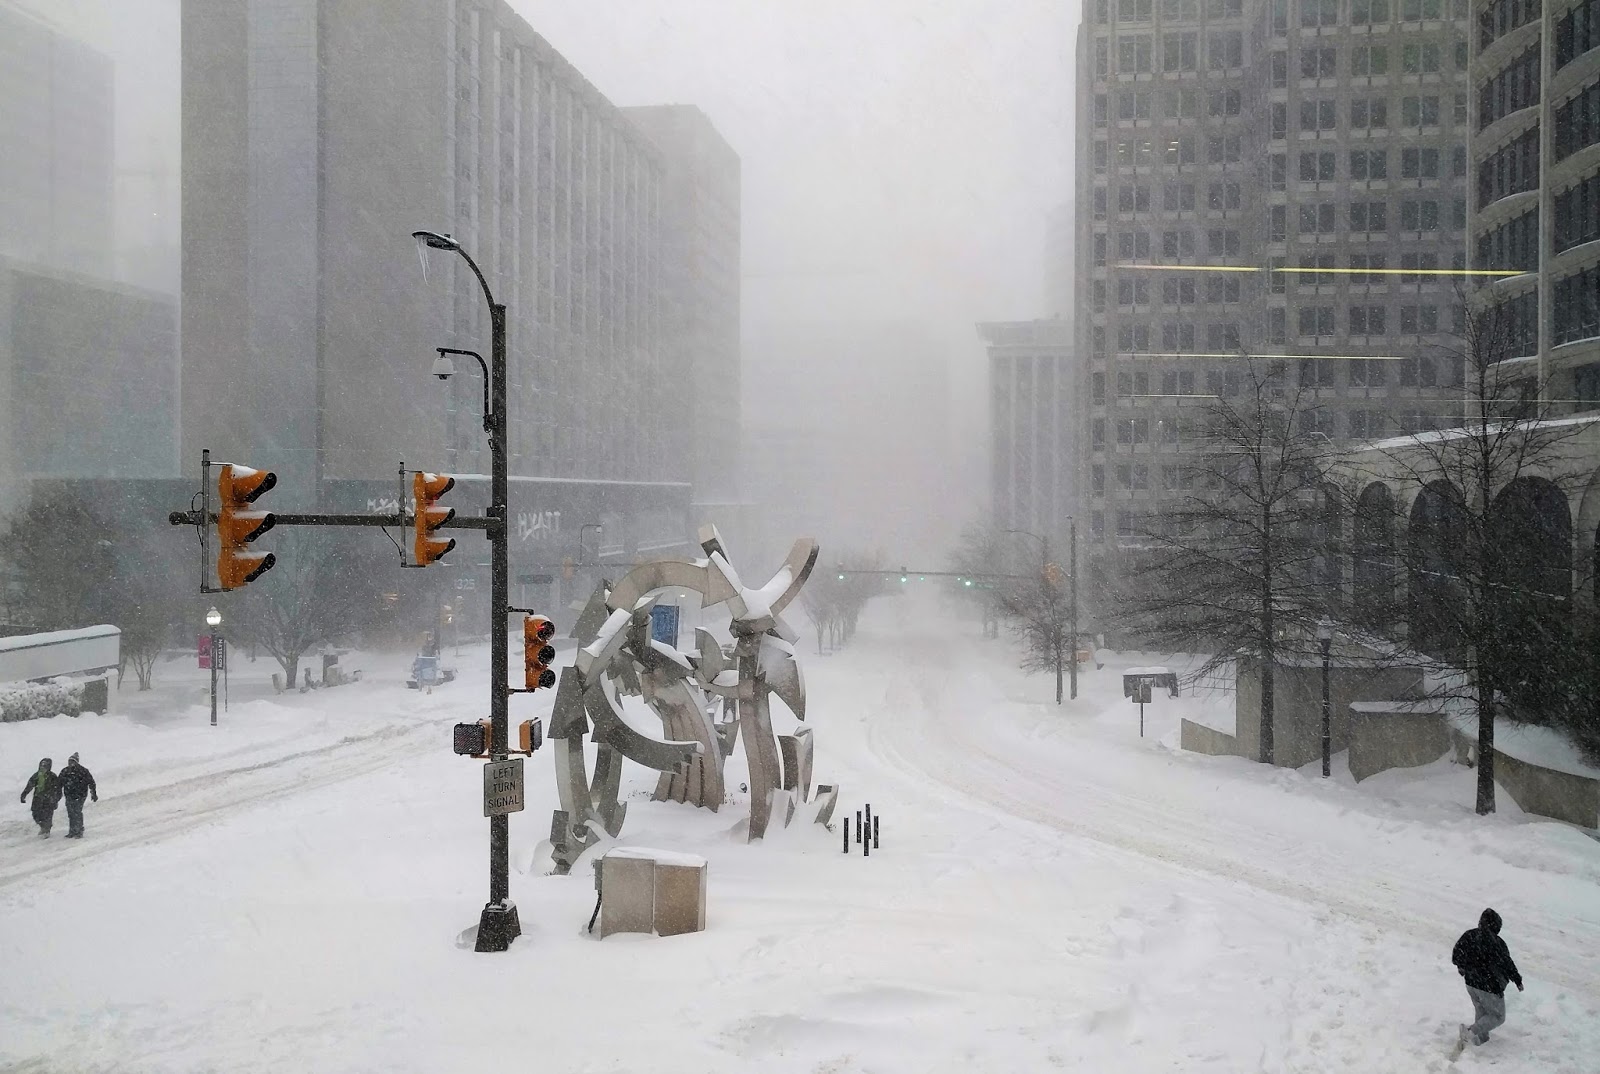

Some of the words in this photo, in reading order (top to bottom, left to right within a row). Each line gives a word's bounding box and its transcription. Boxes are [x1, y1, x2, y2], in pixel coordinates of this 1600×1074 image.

[367, 498, 417, 515] HYAT
[517, 511, 561, 541] HYATT
[493, 766, 514, 779] LEFT
[493, 780, 516, 793] TURN
[488, 794, 520, 808] SIGNAL
